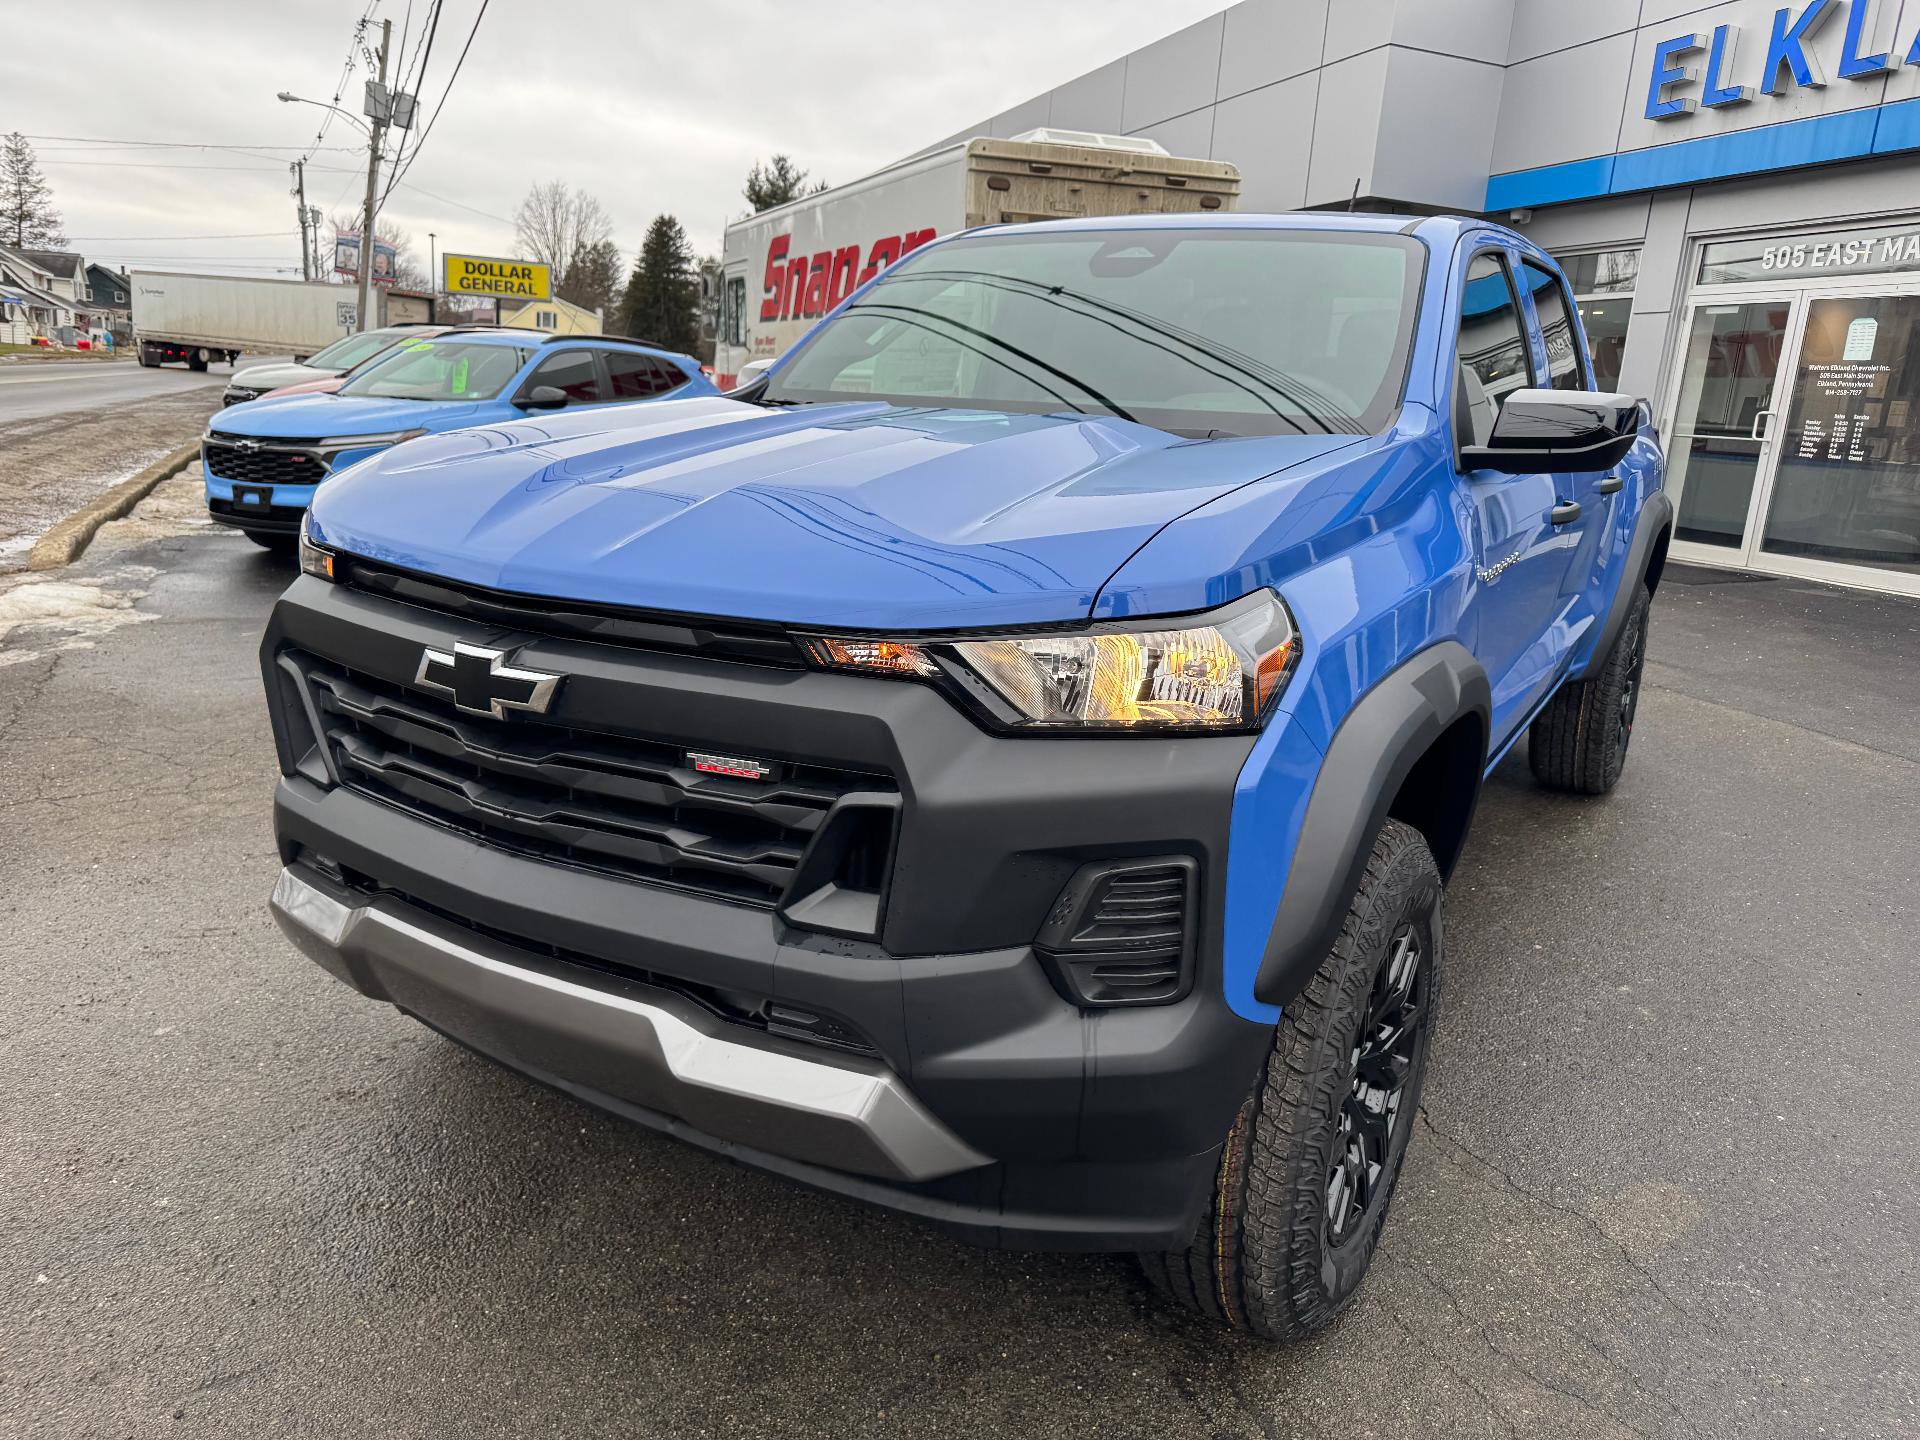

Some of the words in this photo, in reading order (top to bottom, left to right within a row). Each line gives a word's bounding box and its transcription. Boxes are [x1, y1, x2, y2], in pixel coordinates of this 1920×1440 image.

[1644, 0, 1920, 121] ELKL
[1761, 243, 1808, 270] 505
[1811, 238, 1878, 268] EAST
[464, 261, 534, 280] DOLLAR
[459, 276, 538, 296] GENERAL
[340, 314, 356, 325] 35
[1838, 380, 1874, 388] Pennsylvania
